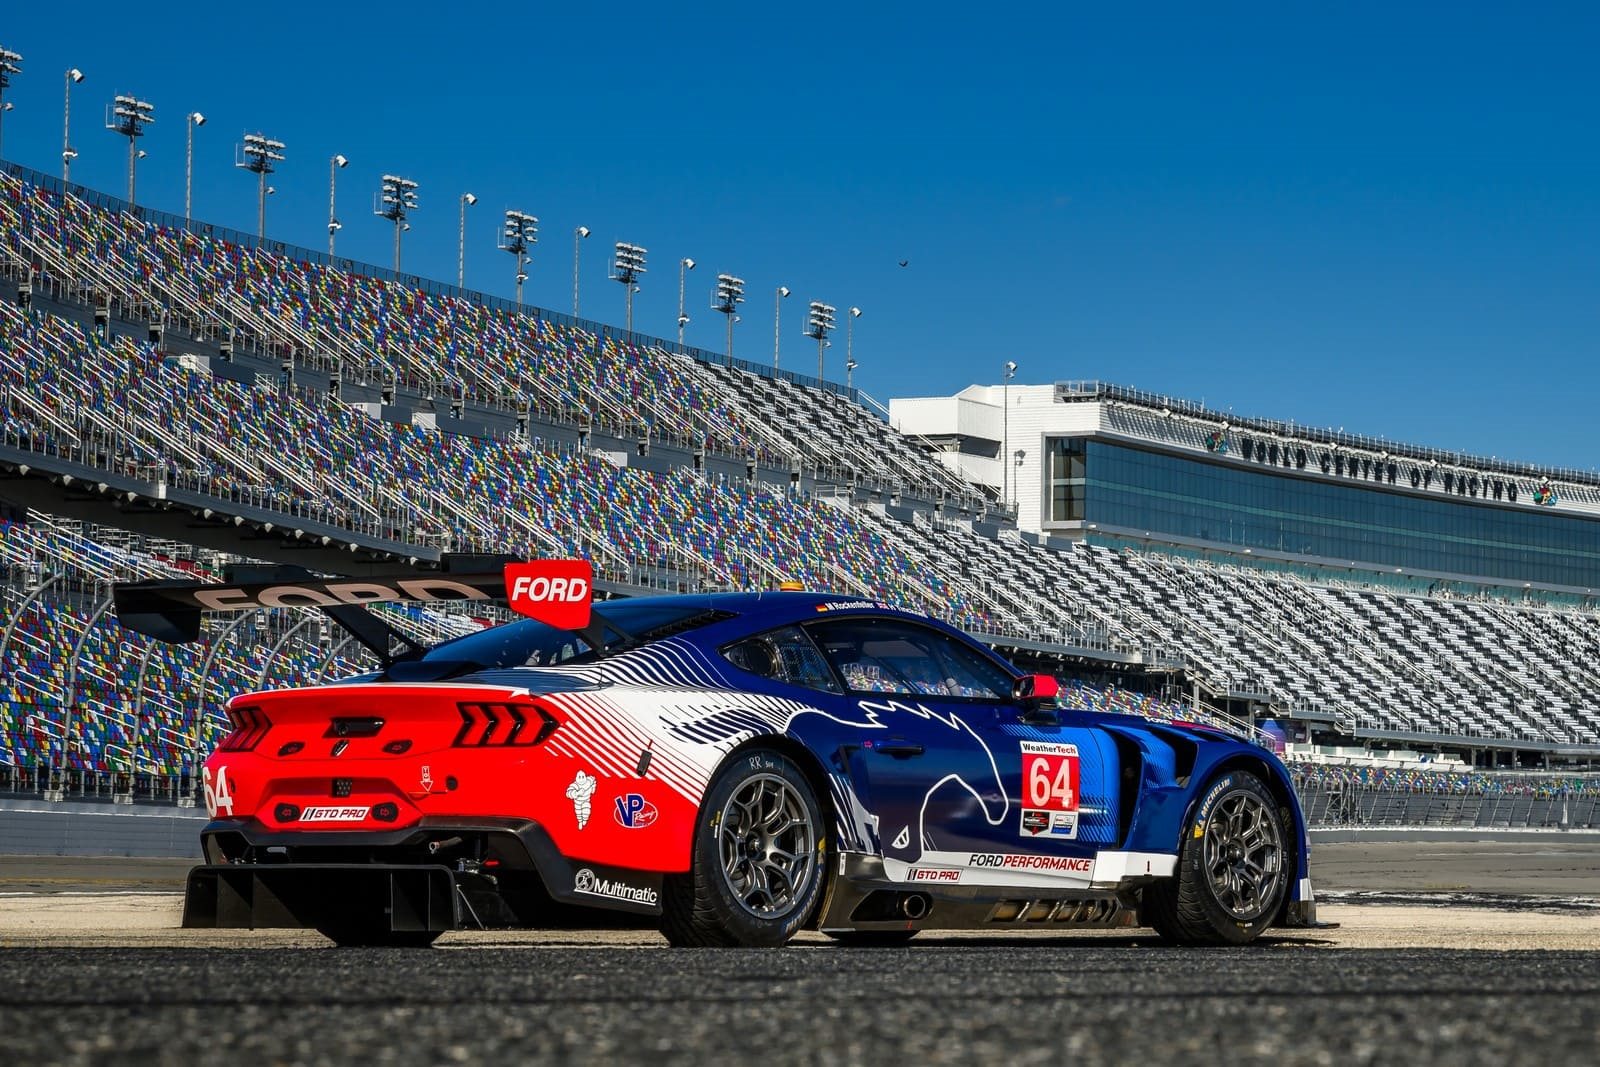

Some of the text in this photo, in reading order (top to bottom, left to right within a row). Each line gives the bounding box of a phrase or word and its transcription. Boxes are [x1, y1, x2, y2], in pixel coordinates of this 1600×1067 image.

[1242, 438, 1518, 502] WORLD CENTER OF RACING
[511, 577, 589, 603] FORD
[1022, 743, 1077, 755] WeatherTech
[202, 765, 233, 818] 64
[1030, 757, 1073, 808] 64
[314, 808, 366, 819] GTD PRO
[614, 793, 645, 828] VP
[917, 870, 960, 881] GTD PRO
[593, 878, 658, 903] Multimatic
